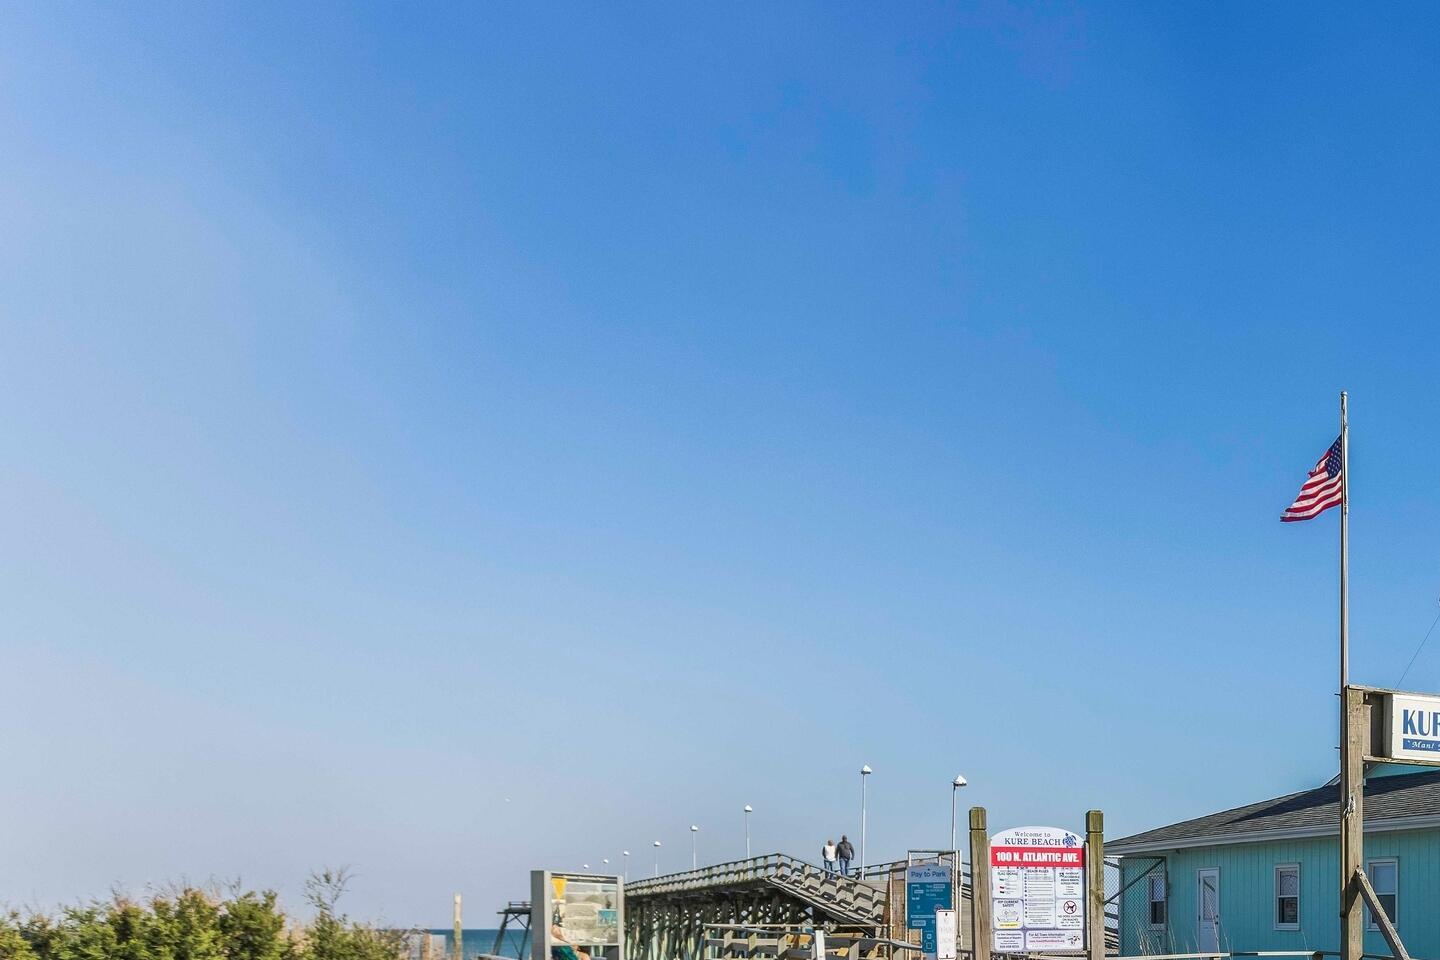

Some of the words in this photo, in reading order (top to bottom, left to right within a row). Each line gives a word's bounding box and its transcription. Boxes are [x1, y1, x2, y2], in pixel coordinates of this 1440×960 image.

[1004, 837, 1029, 845] KURE
[1031, 838, 1061, 846] BEACH
[996, 851, 1012, 862] 100
[1013, 852, 1022, 862] N.
[1022, 852, 1061, 862] ATLANTIC
[911, 871, 922, 879] Pay
